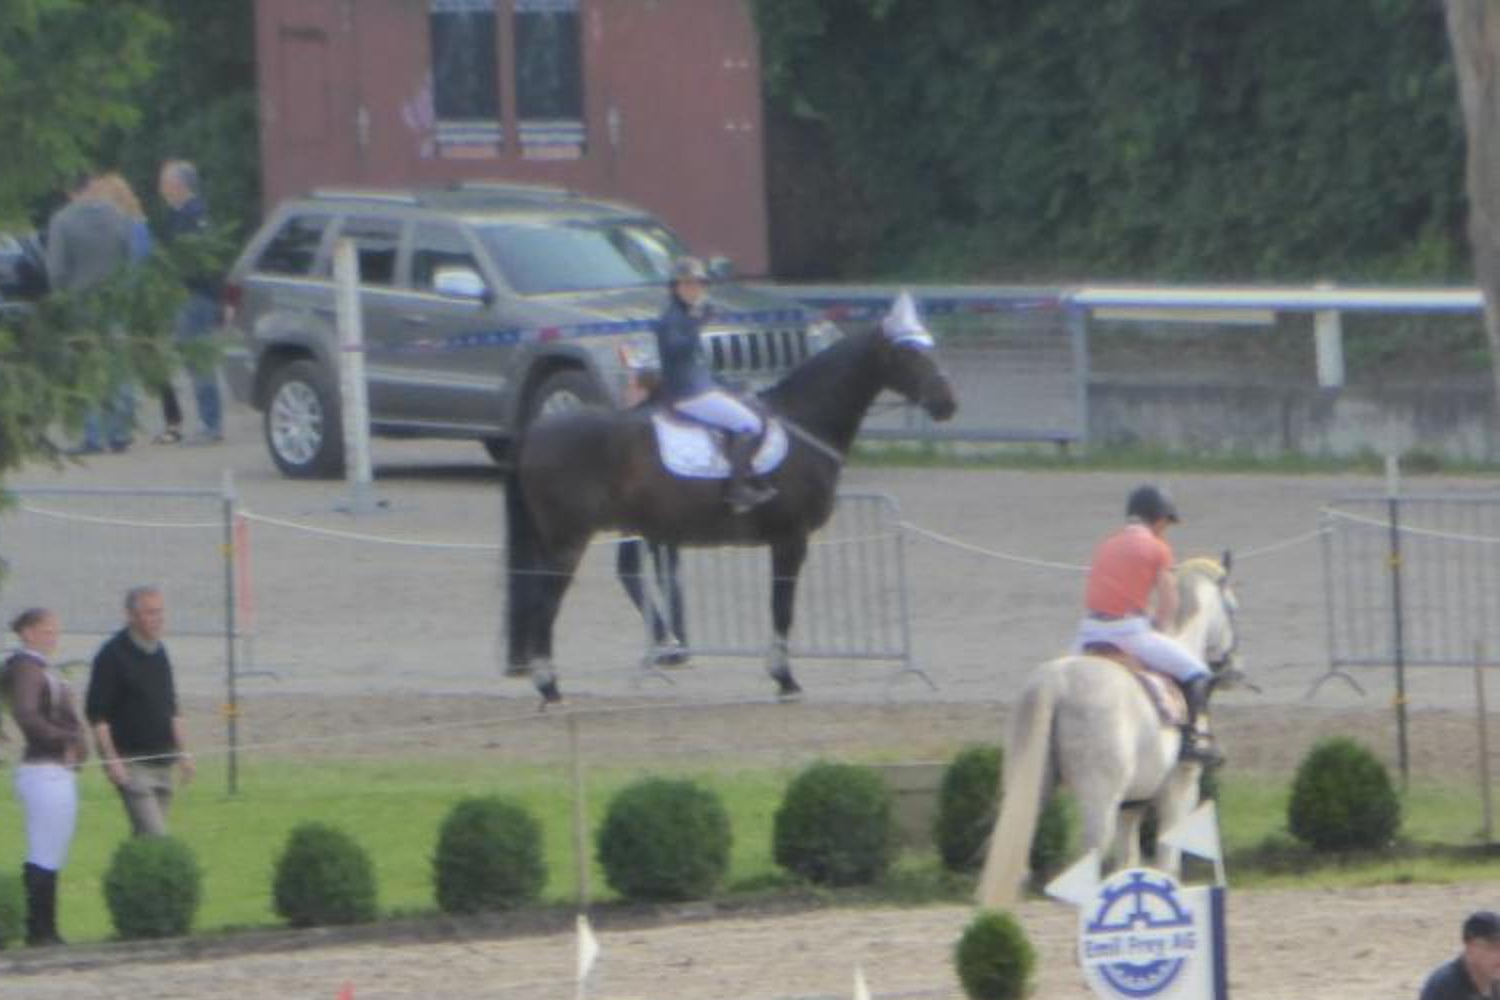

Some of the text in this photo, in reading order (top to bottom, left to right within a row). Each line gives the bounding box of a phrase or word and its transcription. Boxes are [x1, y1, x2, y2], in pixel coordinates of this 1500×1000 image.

[1086, 931, 1197, 958] Emil Frey AG
